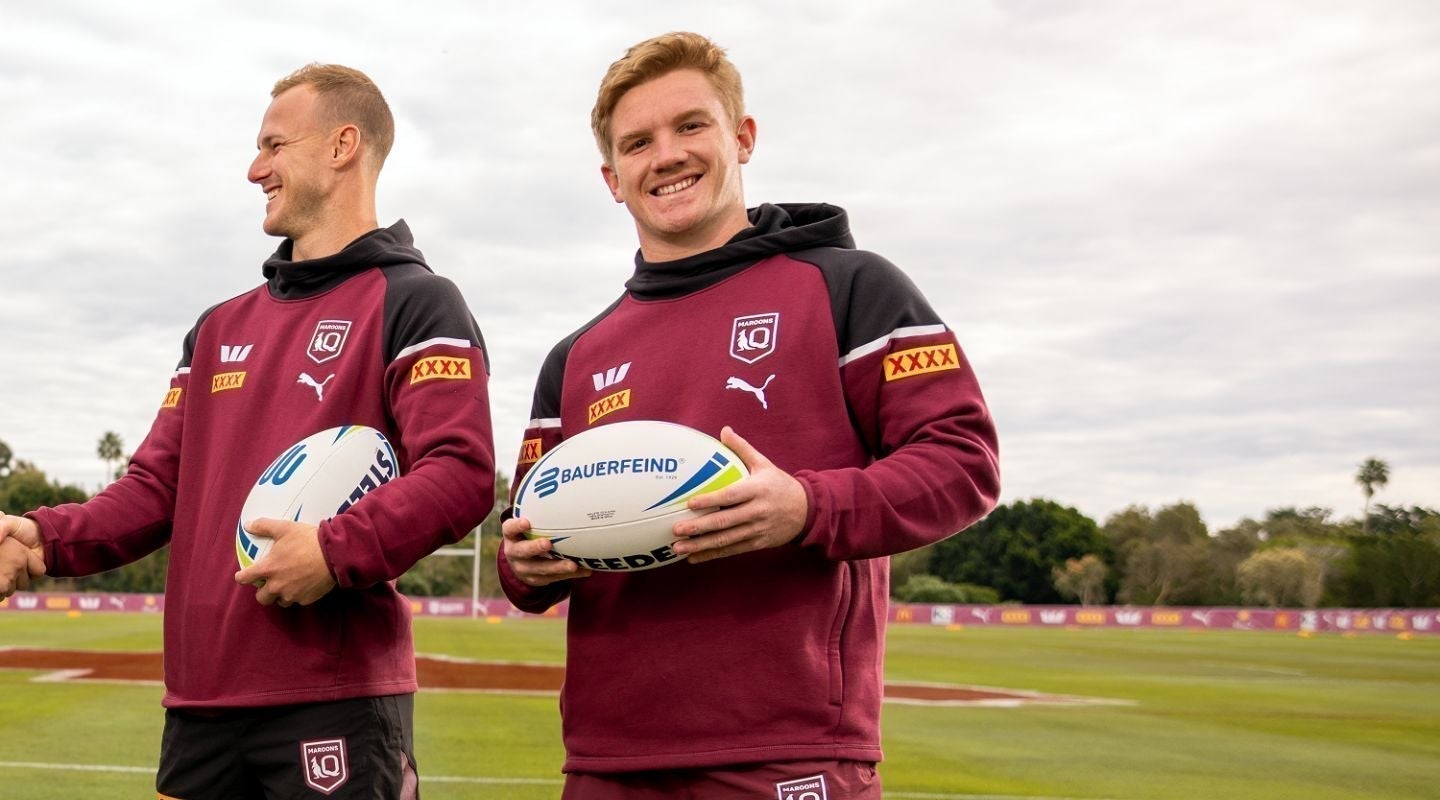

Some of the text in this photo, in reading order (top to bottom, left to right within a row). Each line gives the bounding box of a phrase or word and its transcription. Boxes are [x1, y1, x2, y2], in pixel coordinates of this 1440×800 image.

[738, 318, 773, 327] MAROONS
[414, 360, 466, 380] XXXX
[889, 348, 954, 375] XXXX
[214, 374, 244, 389] XXXX
[591, 393, 626, 420] XXXX
[561, 458, 678, 484] BAUERFEIND
[782, 782, 820, 792] MAROONS
